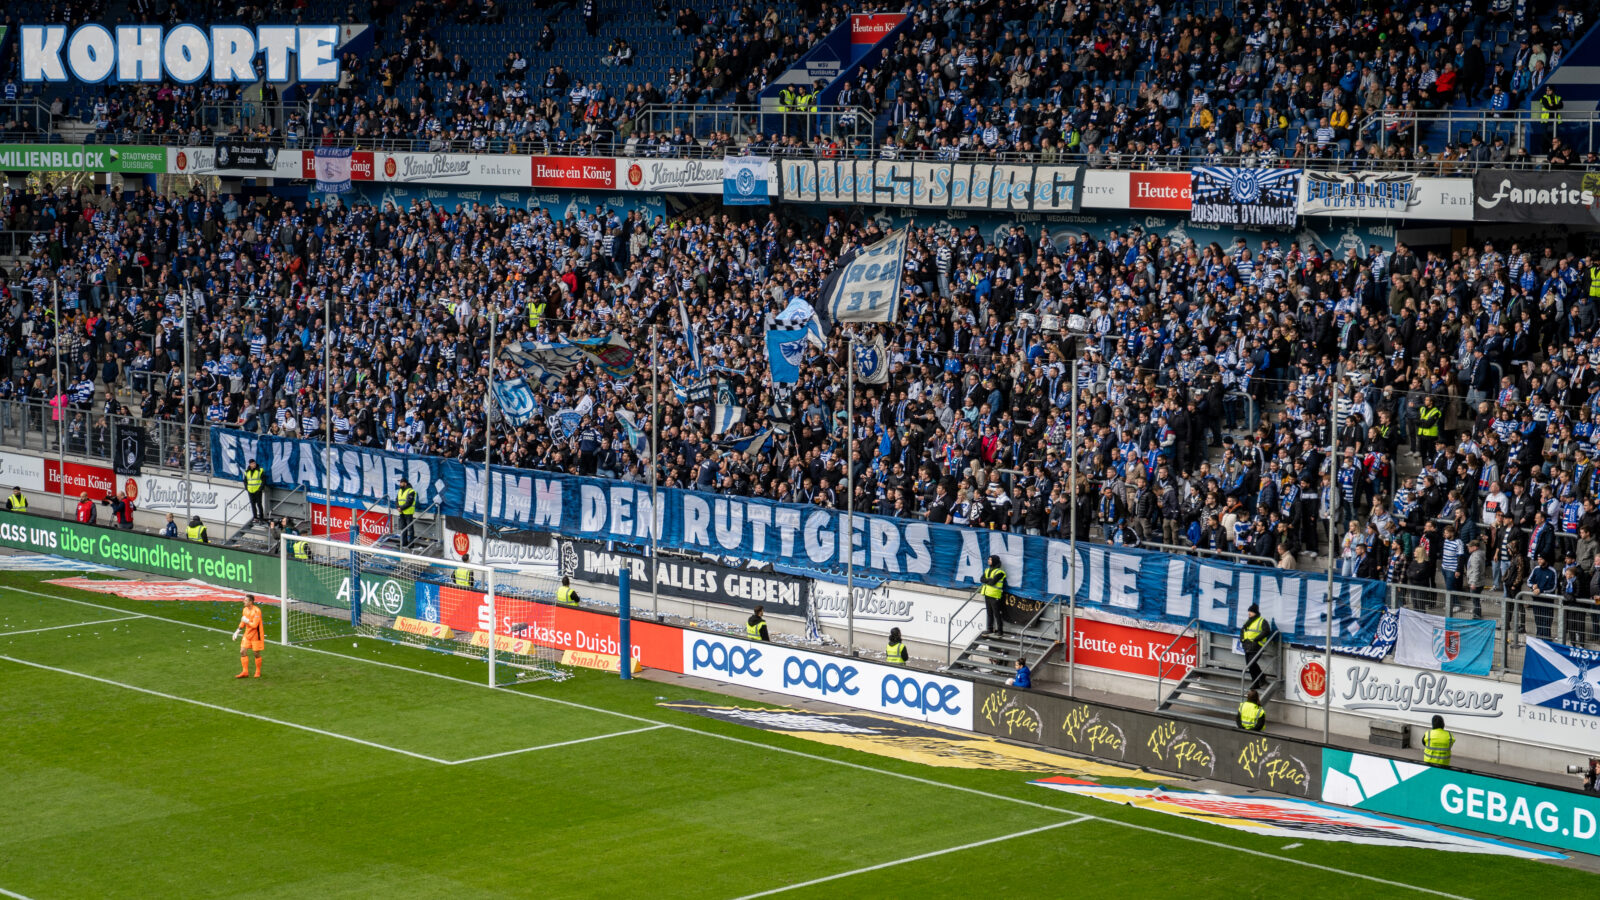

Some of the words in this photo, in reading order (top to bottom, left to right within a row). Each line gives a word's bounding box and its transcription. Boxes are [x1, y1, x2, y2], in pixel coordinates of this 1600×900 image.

[852, 22, 872, 33] Heute
[873, 24, 884, 32] ein
[122, 152, 163, 161] STADTWERKE
[122, 161, 154, 169] DUISBURG
[432, 153, 471, 175] Pilsener
[480, 164, 522, 175] Fankurve
[536, 164, 564, 178] Heute
[566, 166, 580, 179] ein
[582, 166, 612, 185] König
[649, 162, 687, 186] König
[686, 160, 724, 181] Pilsene
[1137, 181, 1178, 198] Heute
[1191, 203, 1239, 224] DUISBURG
[73, 474, 87, 487] ein
[87, 475, 113, 497] König
[144, 479, 179, 508] König
[30, 528, 58, 548] uns
[60, 526, 96, 555] über
[99, 535, 194, 573] Gesundheit
[198, 555, 254, 584] reden!
[463, 466, 563, 527] NIMM
[580, 484, 666, 540] DEN
[955, 530, 1024, 589] AN
[1047, 540, 1143, 610] DIE
[1165, 560, 1364, 637] LEINE!
[656, 563, 718, 593] ALLES
[724, 574, 800, 607] GEBEN!
[398, 617, 429, 635] Sinalco
[924, 610, 984, 631] Fankurve
[476, 634, 509, 650] Silco
[576, 629, 642, 662] Duisbg
[1072, 631, 1117, 654] Heute
[1119, 639, 1144, 659] ein
[1147, 642, 1197, 673] König
[1568, 646, 1600, 661] MSV
[568, 651, 610, 669] Sinalco
[692, 638, 764, 678] pape
[783, 656, 861, 696] pape
[881, 673, 962, 716] pape
[1342, 665, 1415, 712] König
[1412, 671, 1504, 712] Pilsener
[1516, 703, 1599, 731] Fankurve
[1561, 698, 1598, 715] PTFC
[1005, 708, 1039, 735] Flac
[1087, 725, 1123, 752] Flac
[1173, 741, 1211, 769] Flac
[1265, 759, 1305, 787] Flac
[1439, 782, 1598, 840] GEBAG.D
